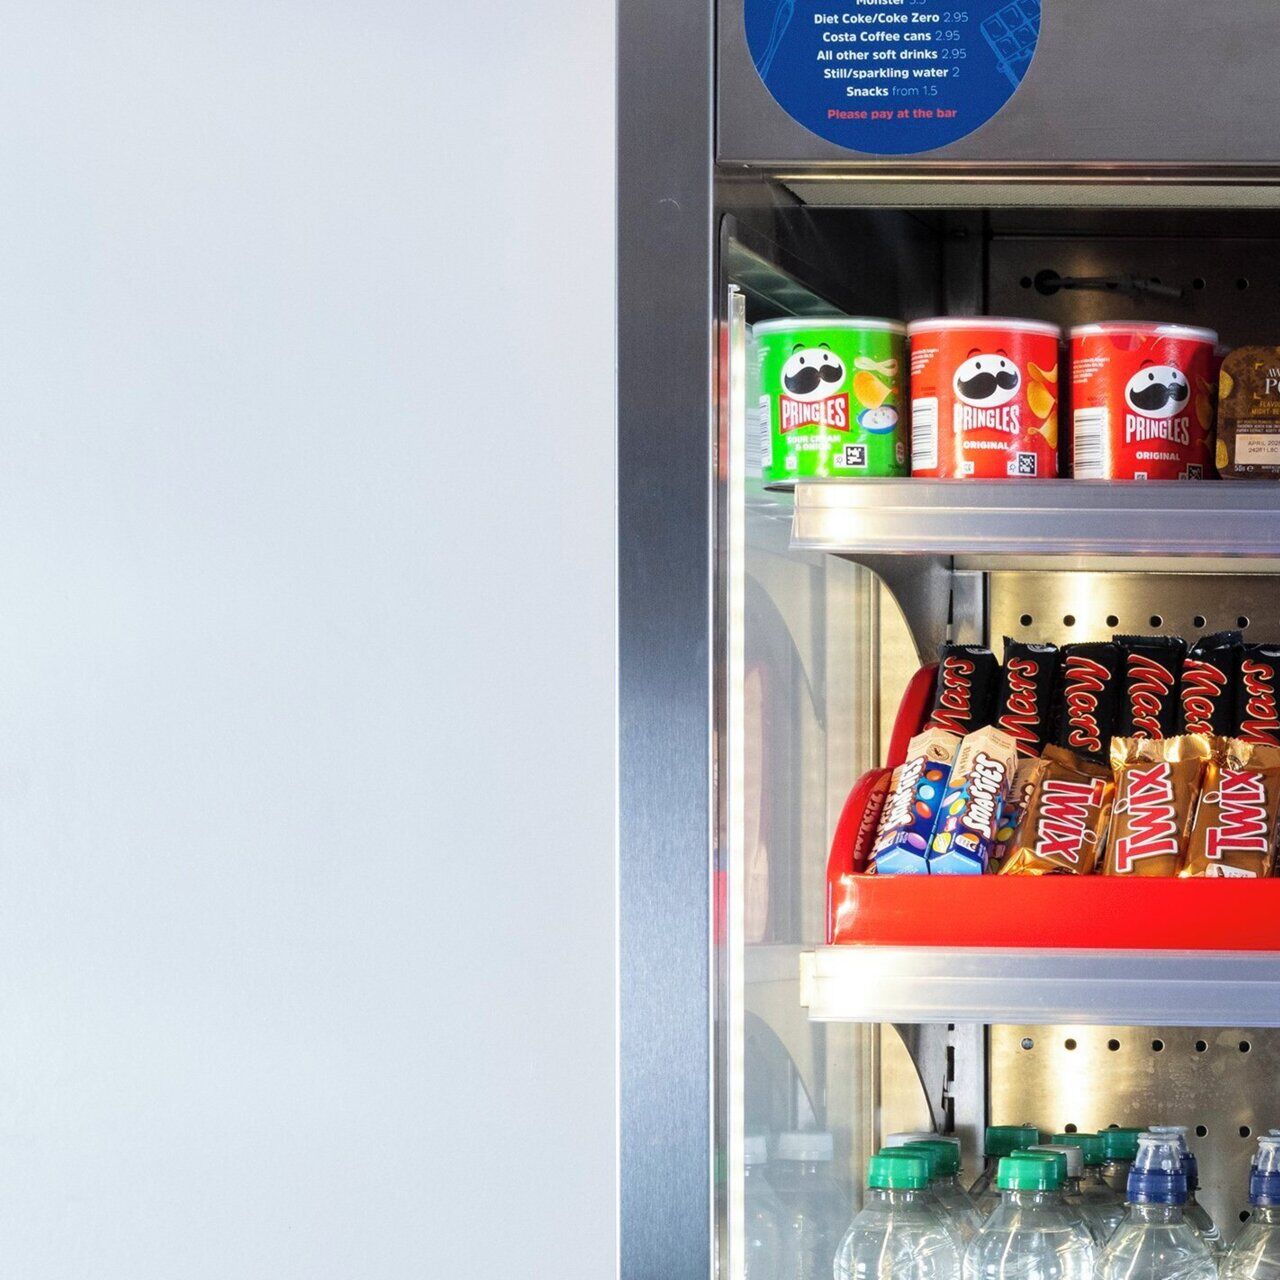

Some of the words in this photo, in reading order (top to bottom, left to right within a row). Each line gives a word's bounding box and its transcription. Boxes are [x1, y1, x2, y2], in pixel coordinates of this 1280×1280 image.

[814, 14, 839, 24] Diet
[842, 13, 909, 24] Coke/Coke
[911, 13, 939, 24] Zero
[943, 13, 969, 23] 2.95
[822, 32, 857, 43] Costa
[860, 31, 900, 42] Coffee
[903, 32, 931, 42] cans
[935, 31, 960, 42] 2.95
[817, 50, 833, 61] All
[836, 50, 869, 60] other
[872, 49, 896, 60] soft
[899, 49, 938, 60] drinks
[942, 49, 967, 59] 2.95
[781, 399, 846, 428] PRINGLES
[1126, 414, 1189, 445] PRINGLES
[1135, 451, 1181, 462] ORIGINAL
[1066, 655, 1112, 752] Mars
